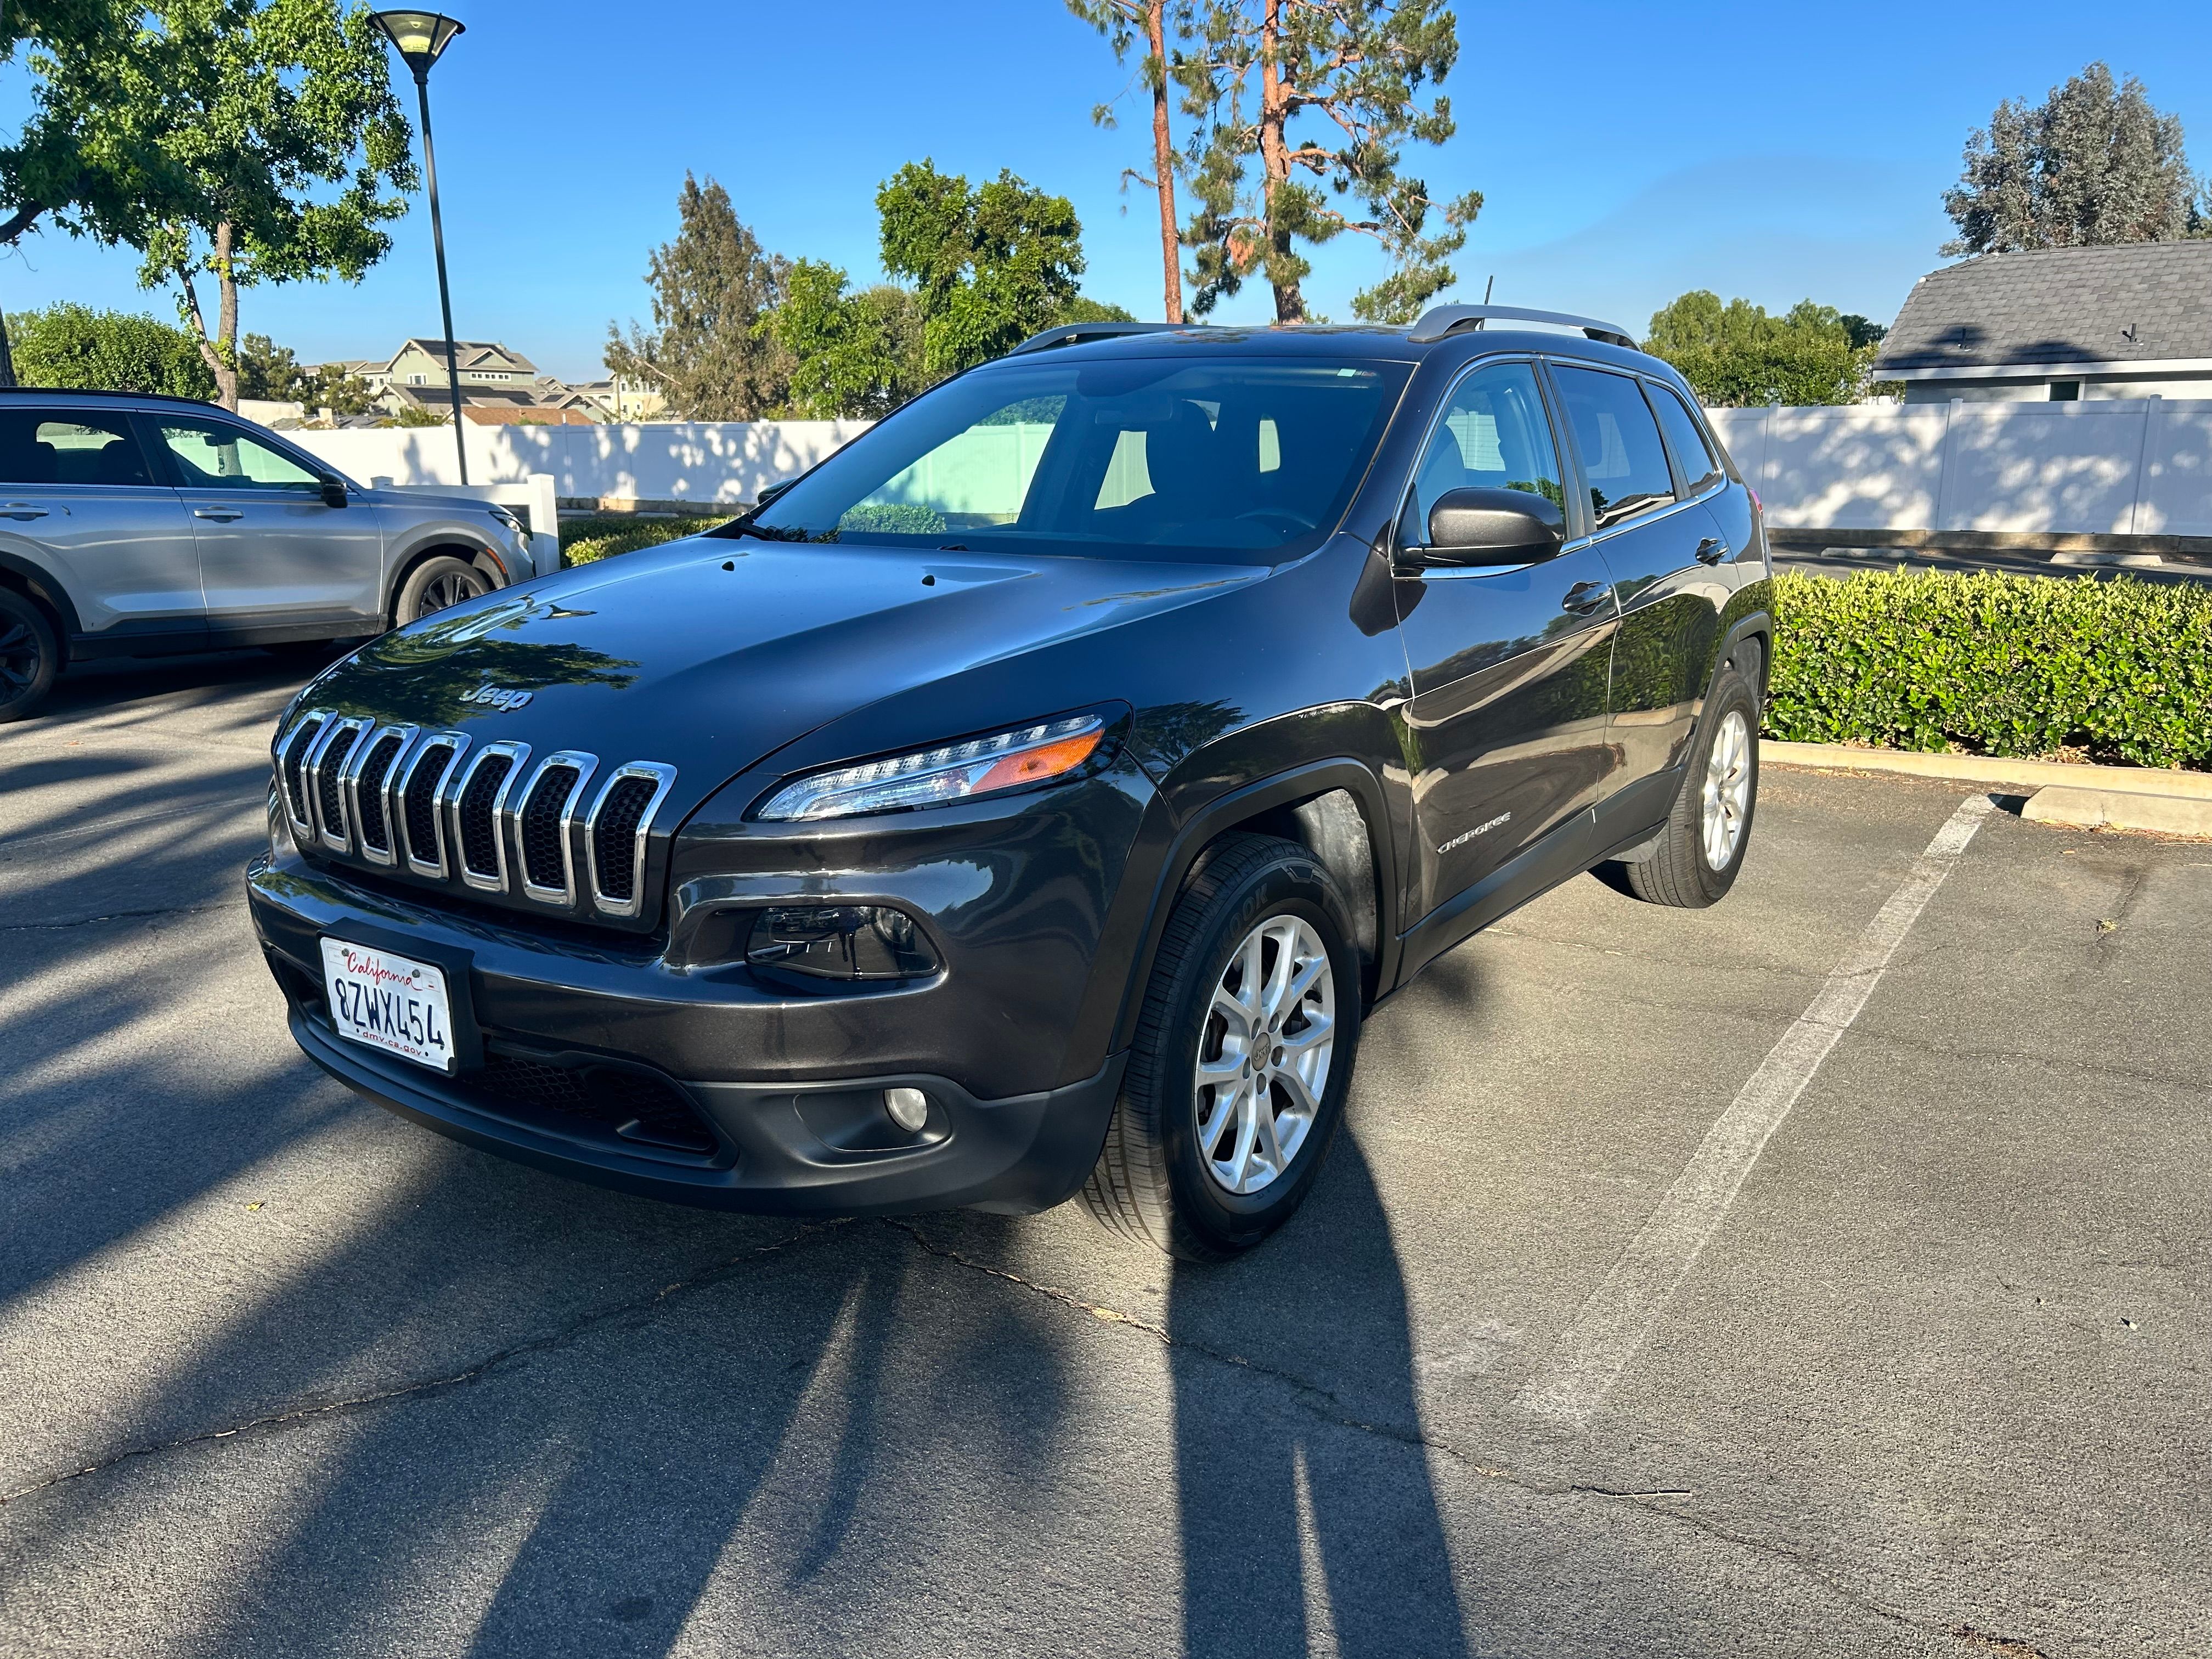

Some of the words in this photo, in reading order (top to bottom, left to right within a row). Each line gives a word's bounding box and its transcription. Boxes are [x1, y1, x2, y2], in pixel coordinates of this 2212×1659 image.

[459, 682, 533, 712] Jeep
[1437, 811, 1511, 854] CHEROKEE
[347, 952, 423, 990] California
[335, 978, 445, 1050] 8ZWX454
[363, 1031, 422, 1056] dmv.ca.gov
